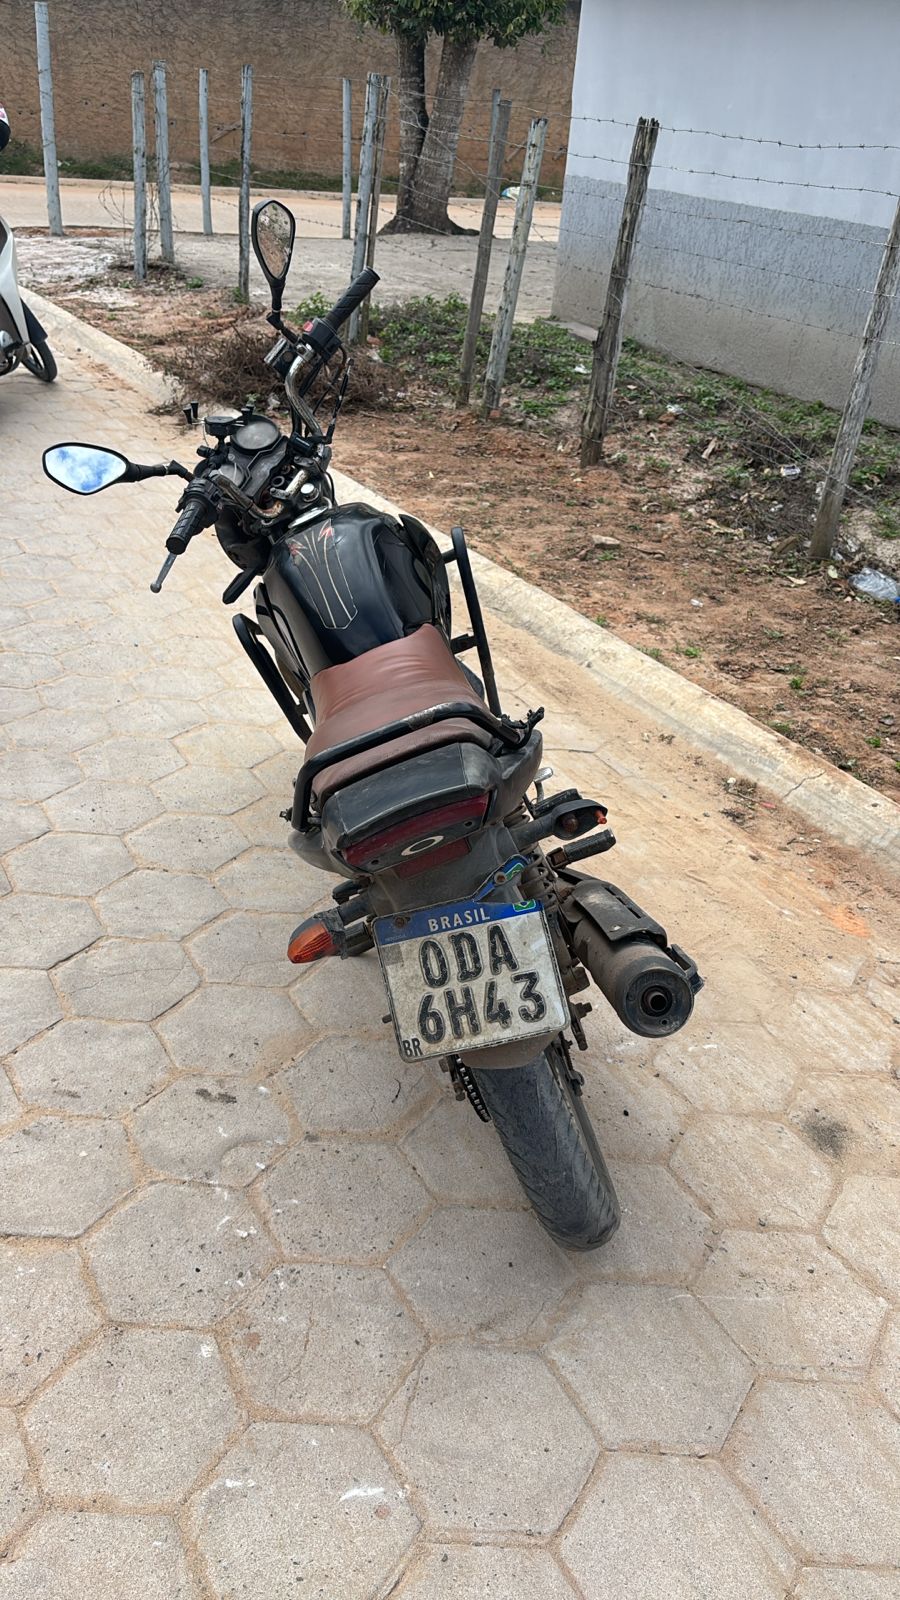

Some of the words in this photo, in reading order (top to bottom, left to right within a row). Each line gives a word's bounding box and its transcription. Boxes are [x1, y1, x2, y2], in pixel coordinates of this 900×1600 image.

[428, 908, 491, 932] BRASIL
[419, 924, 518, 988] ODA
[418, 970, 546, 1044] 6H43
[403, 1037, 423, 1057] BR
